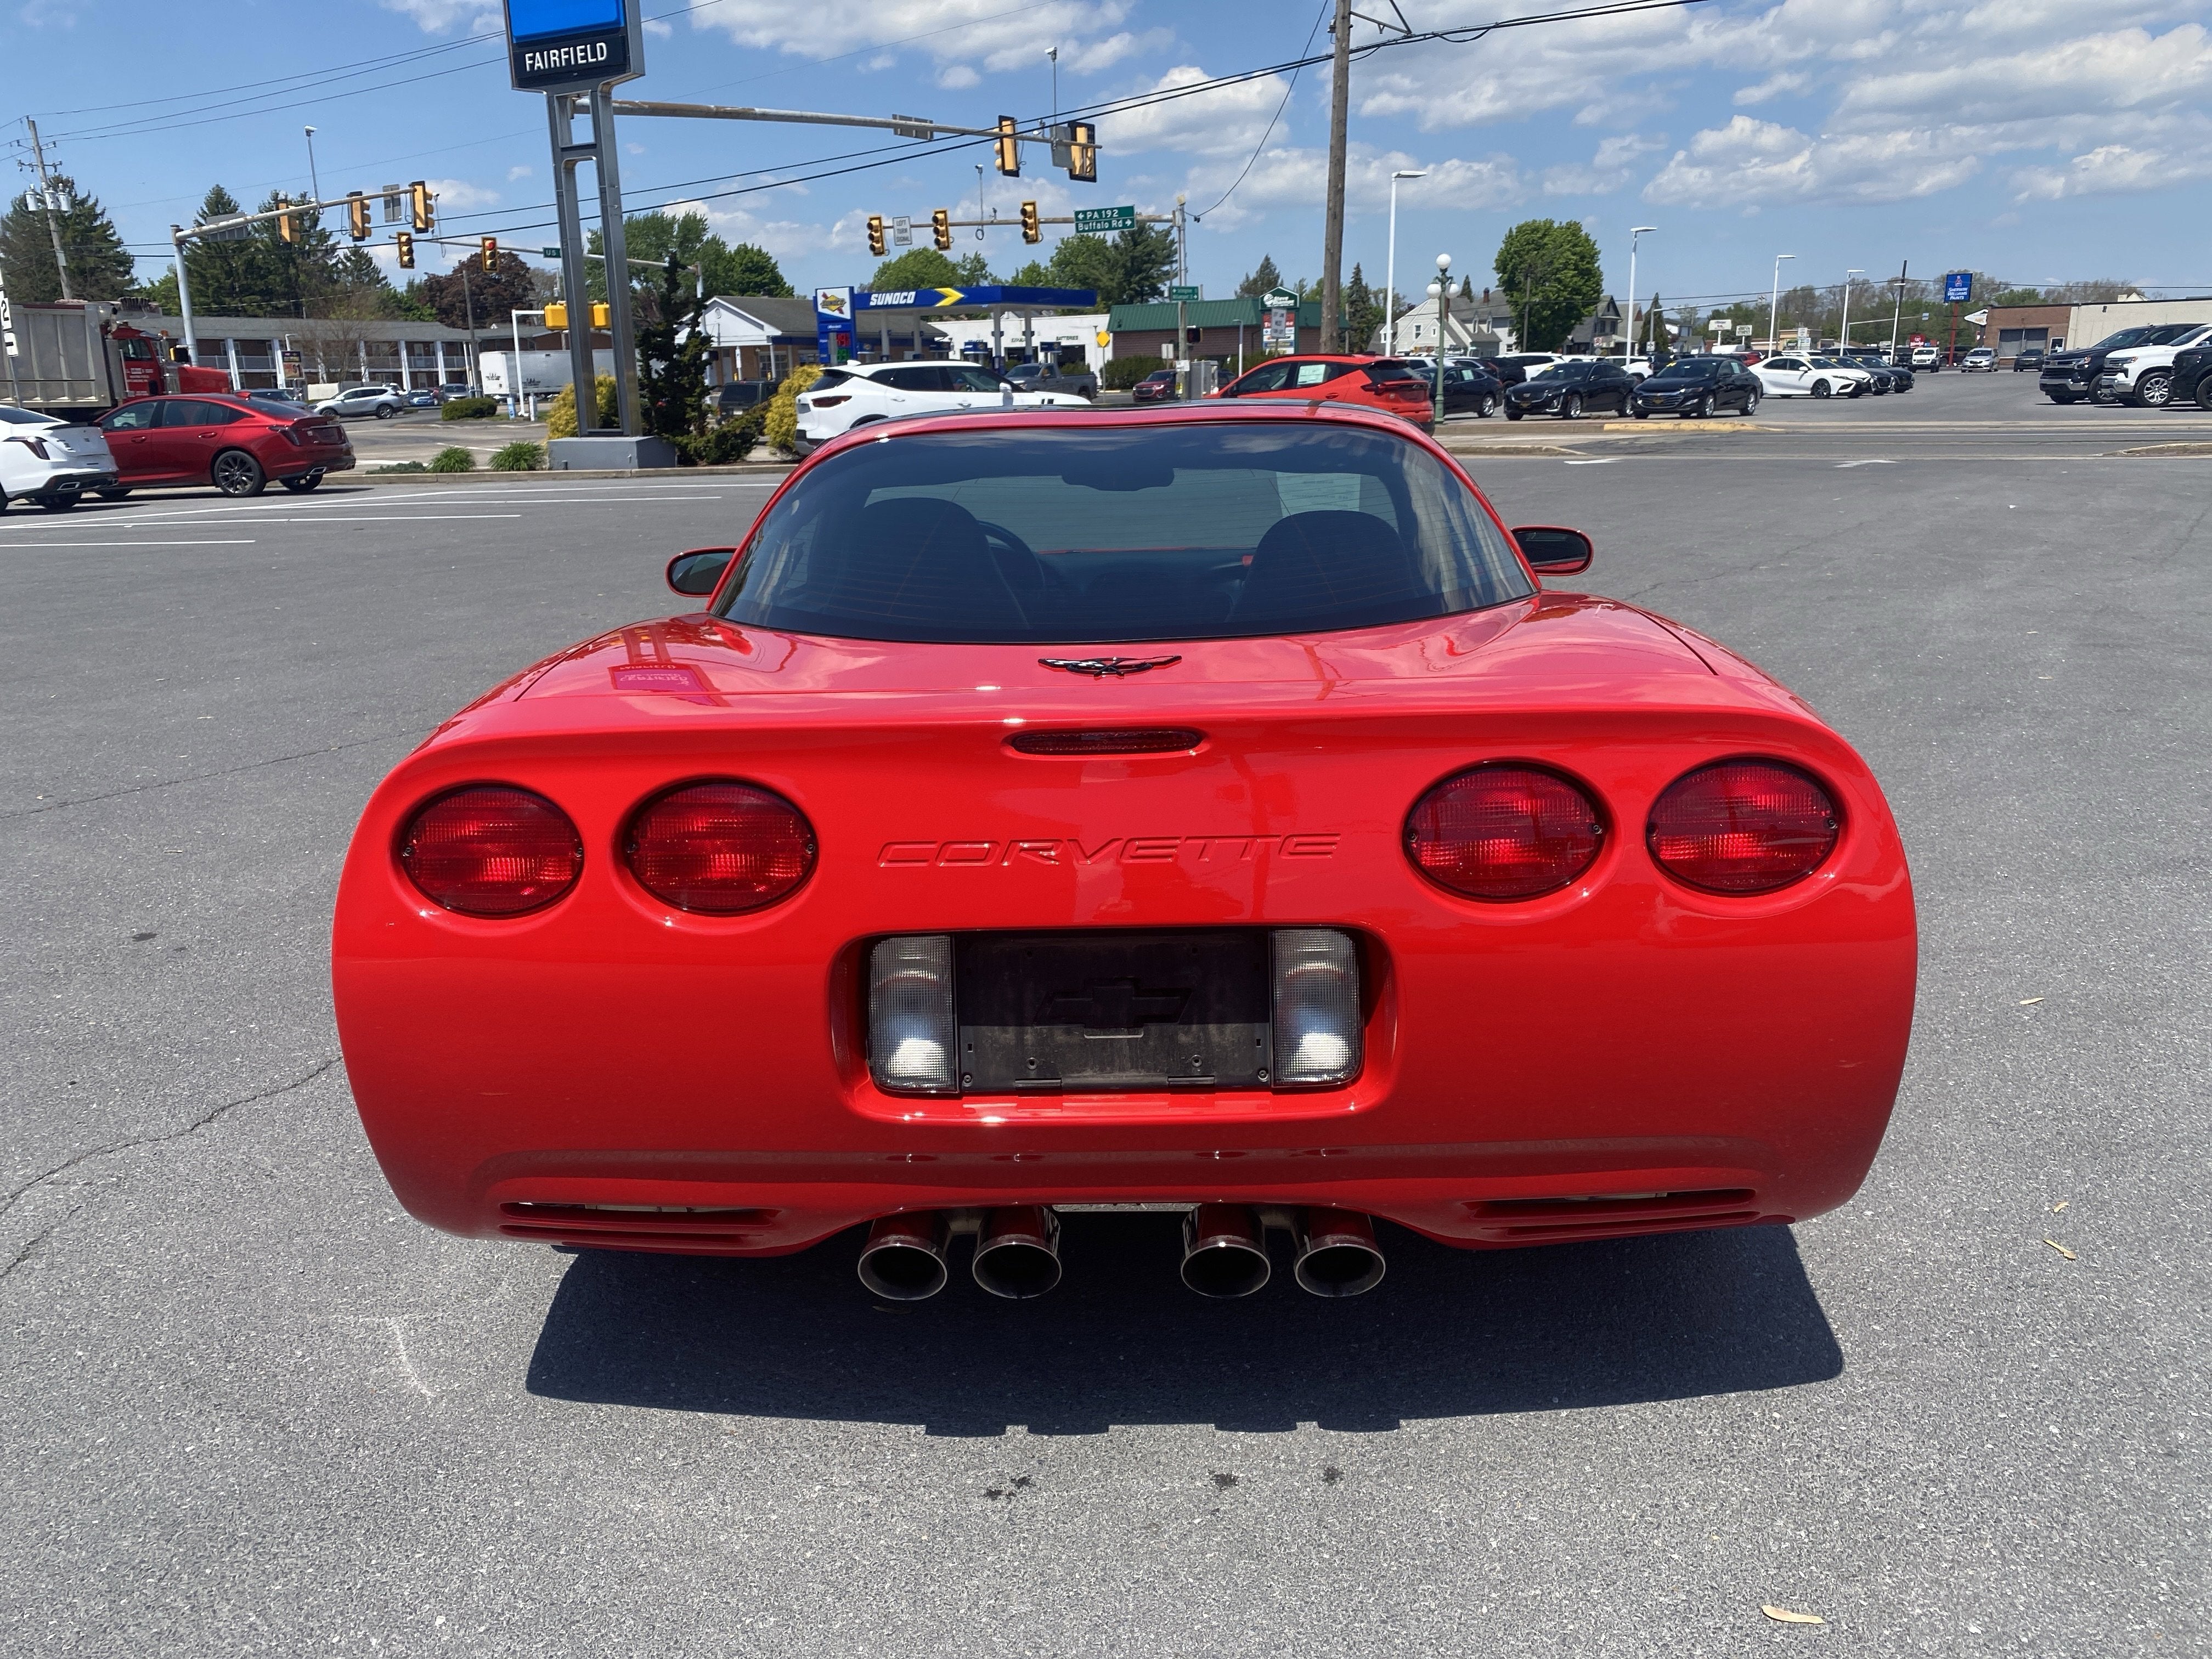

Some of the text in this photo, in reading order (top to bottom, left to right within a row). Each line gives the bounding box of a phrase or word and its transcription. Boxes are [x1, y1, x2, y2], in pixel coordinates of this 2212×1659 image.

[525, 42, 607, 72] FAIRFIELD
[1086, 209, 1119, 219] PA 192
[1078, 219, 1122, 230] Buffalo Rd
[869, 291, 916, 306] SUNOCO
[878, 833, 1342, 868] CORVETTE
